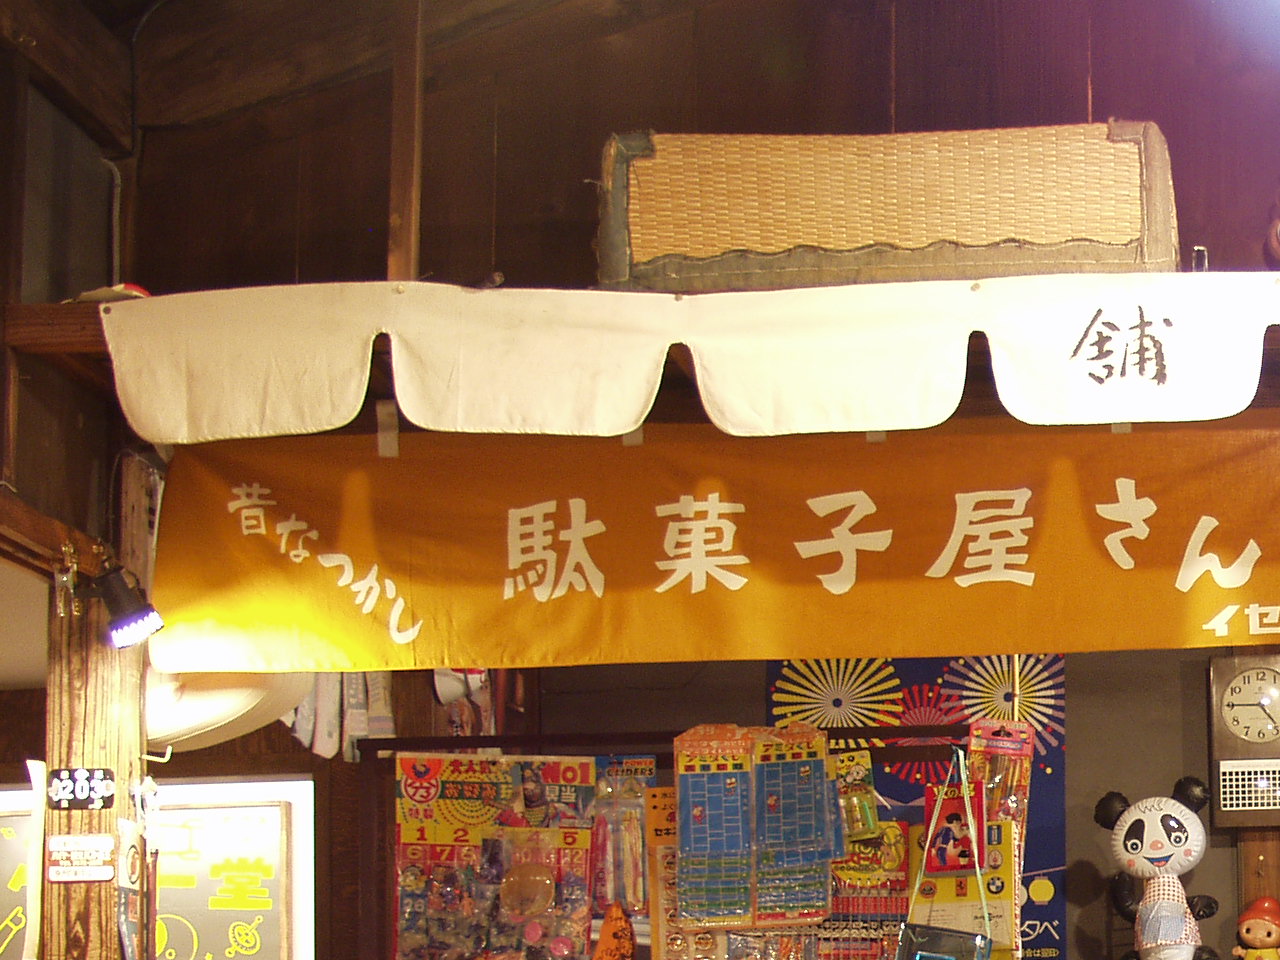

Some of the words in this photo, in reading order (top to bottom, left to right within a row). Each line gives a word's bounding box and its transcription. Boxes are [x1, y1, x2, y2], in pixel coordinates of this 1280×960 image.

[503, 478, 1262, 602] 駄菓子屋さん
[228, 482, 423, 644] 昔なつかし
[416, 828, 428, 842] 1
[453, 828, 469, 843] 2
[563, 831, 579, 845] 5
[436, 847, 451, 861] 7
